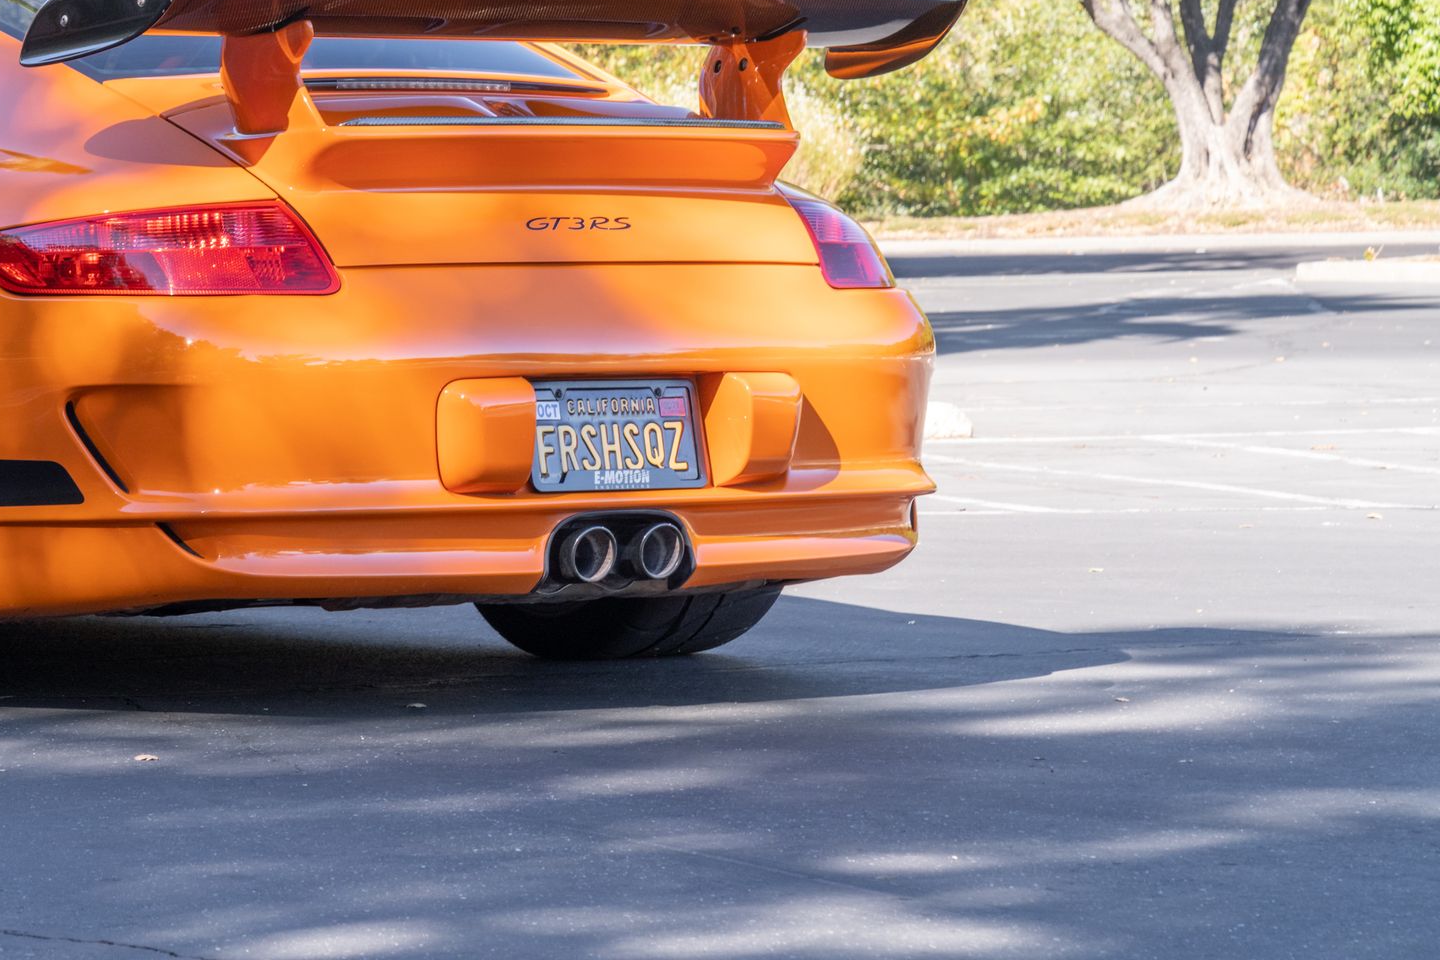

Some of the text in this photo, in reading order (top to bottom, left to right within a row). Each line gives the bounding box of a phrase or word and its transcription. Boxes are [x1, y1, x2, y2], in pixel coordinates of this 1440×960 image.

[536, 403, 558, 419] OCT
[566, 397, 656, 415] CALIFORNIA
[536, 421, 689, 475] FRSHSQZ
[594, 469, 650, 484] E-MOTION
